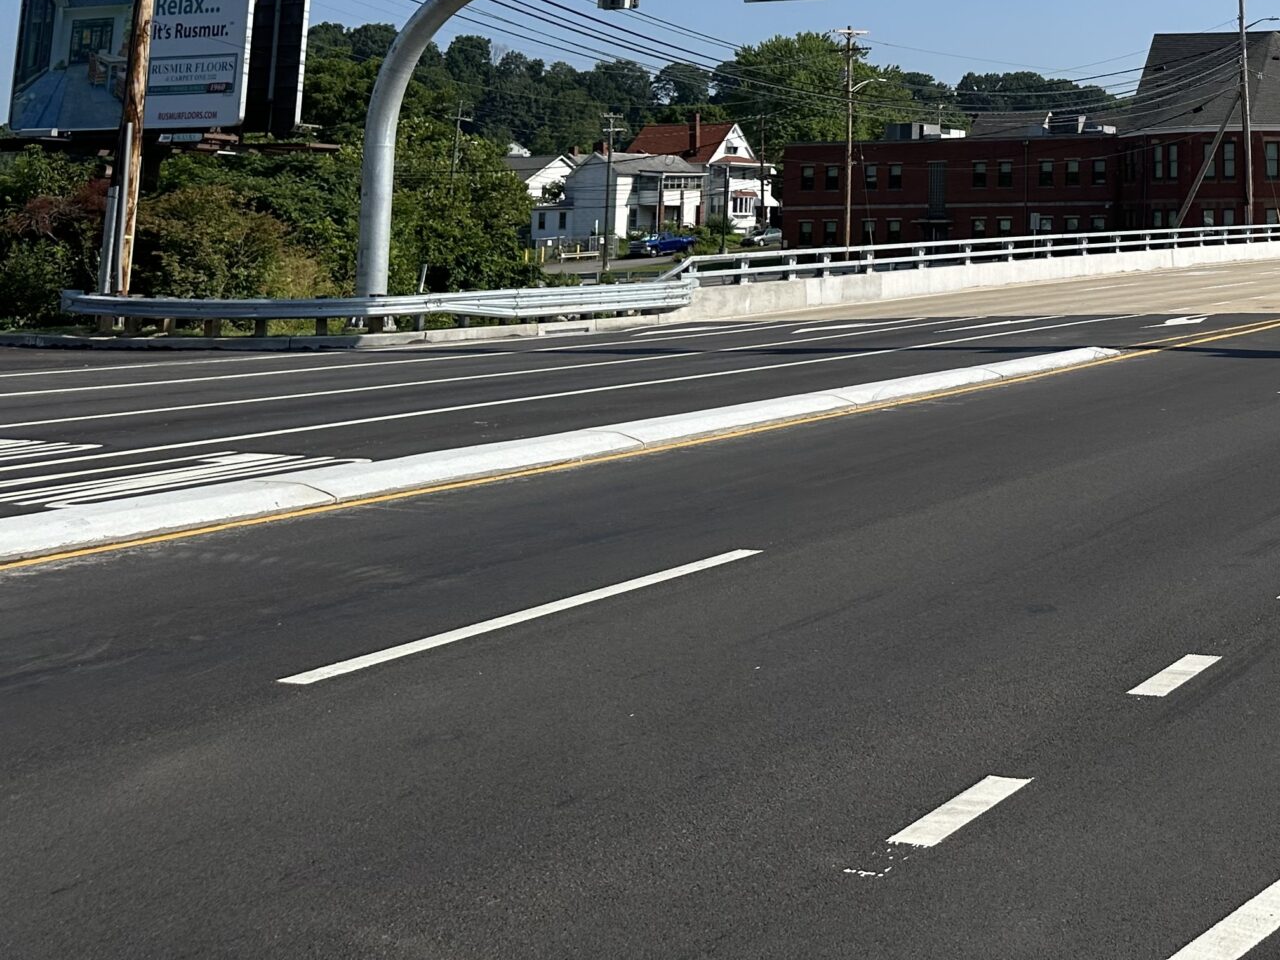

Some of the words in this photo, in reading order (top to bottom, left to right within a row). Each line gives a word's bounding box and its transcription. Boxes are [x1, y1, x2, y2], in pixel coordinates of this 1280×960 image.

[153, 24, 171, 40] It's
[175, 22, 228, 39] Rusmur.
[152, 63, 192, 74] RUSMUR
[195, 61, 234, 73] FLOORS
[158, 111, 218, 120] RUSMURFLOORS.COM
